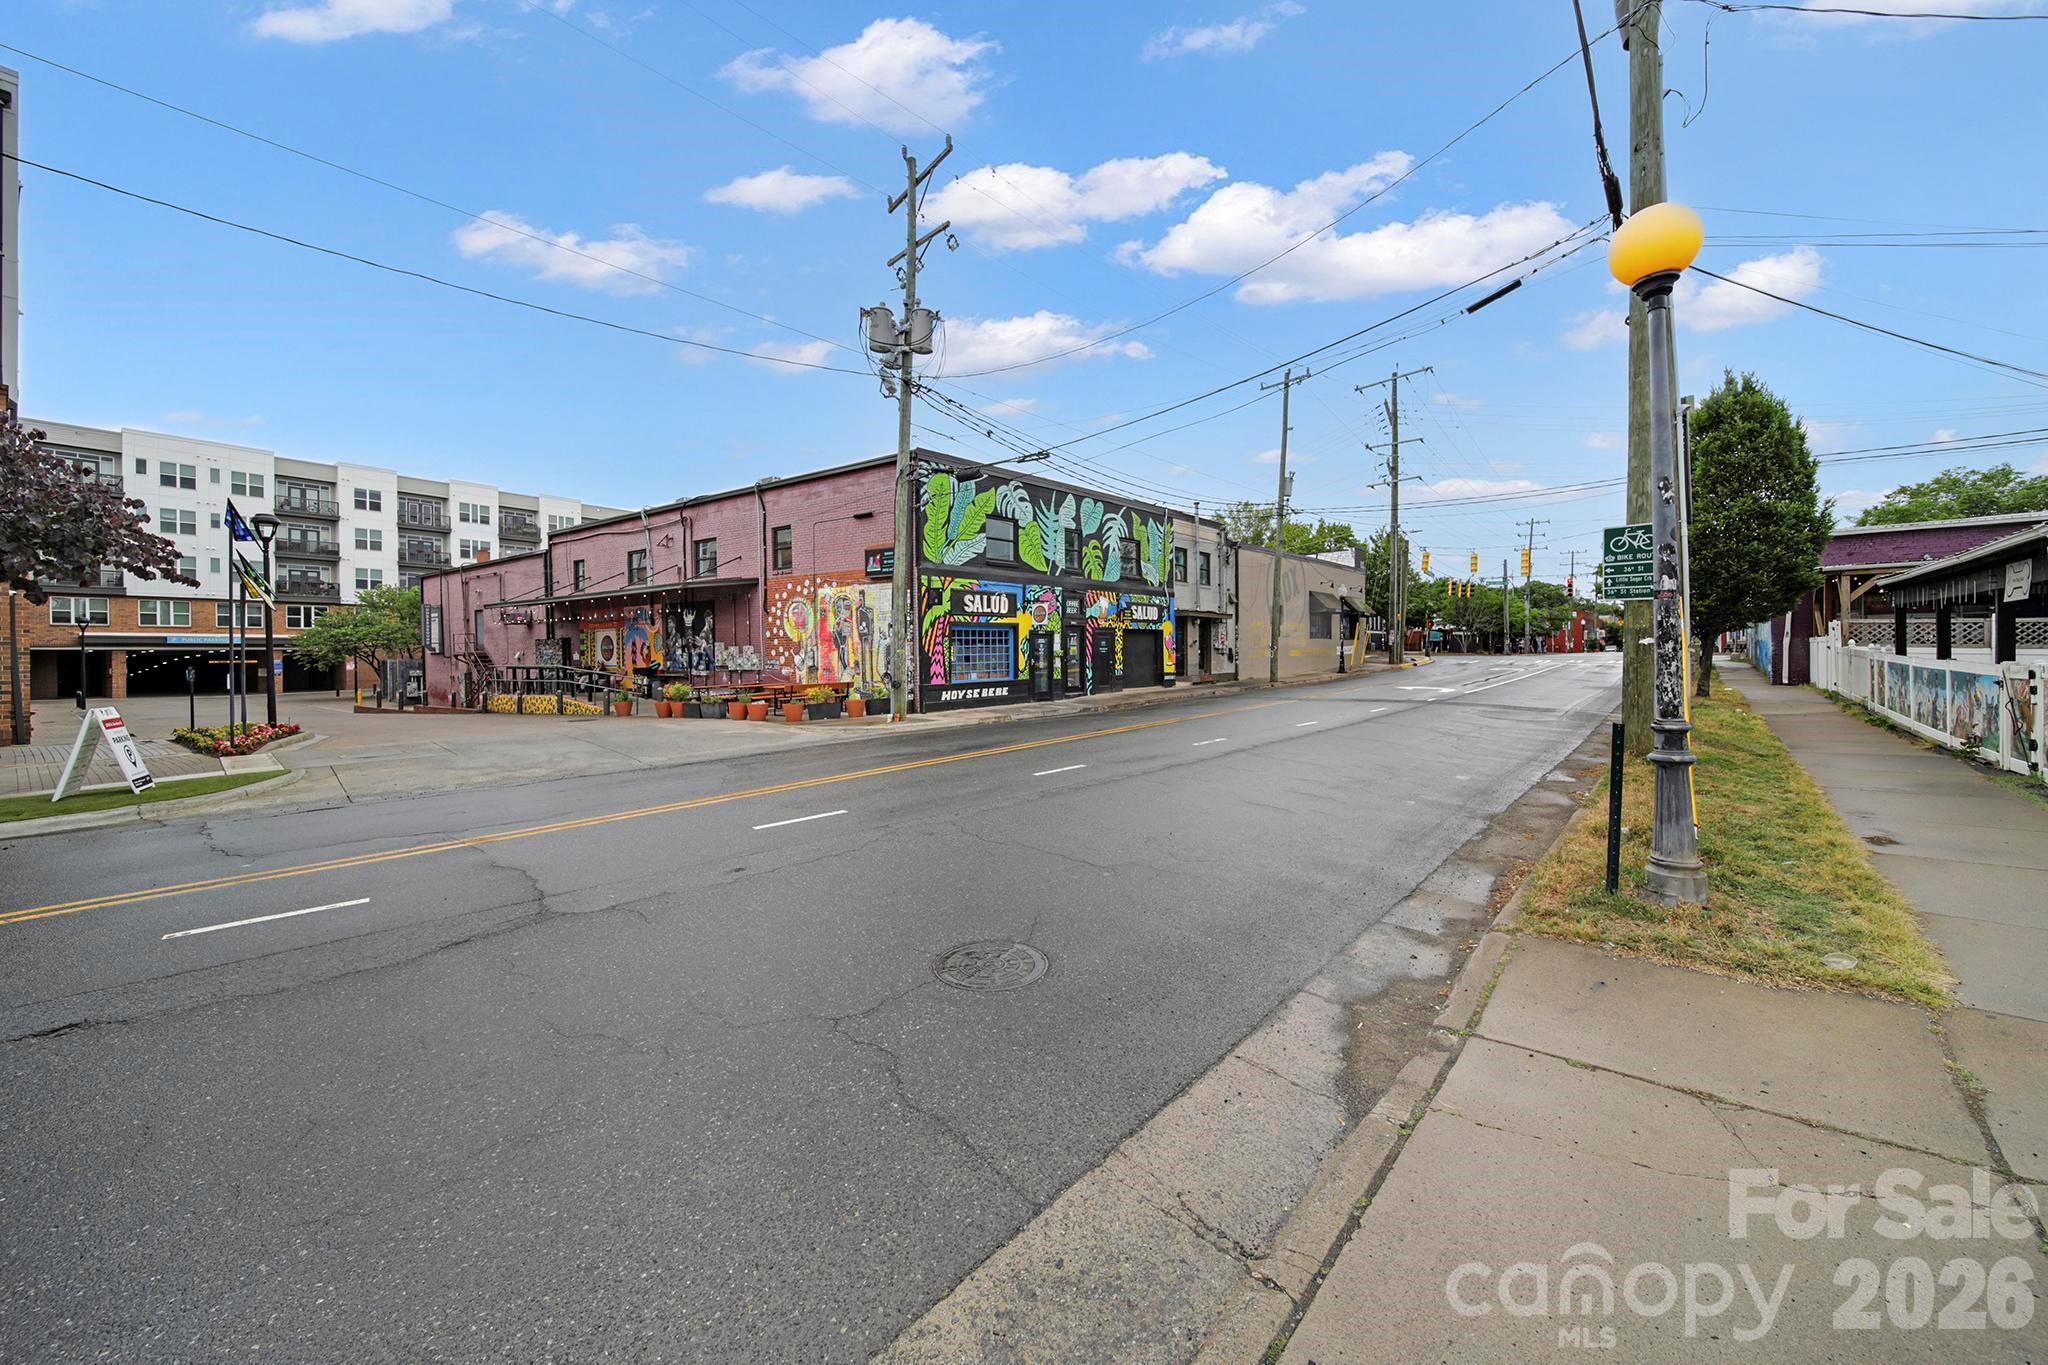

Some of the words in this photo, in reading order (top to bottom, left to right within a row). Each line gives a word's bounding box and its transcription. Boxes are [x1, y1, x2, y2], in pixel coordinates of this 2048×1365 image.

[1131, 605, 1159, 621] SALUD
[981, 686, 1009, 698] BEBE
[112, 734, 132, 744] PARKING
